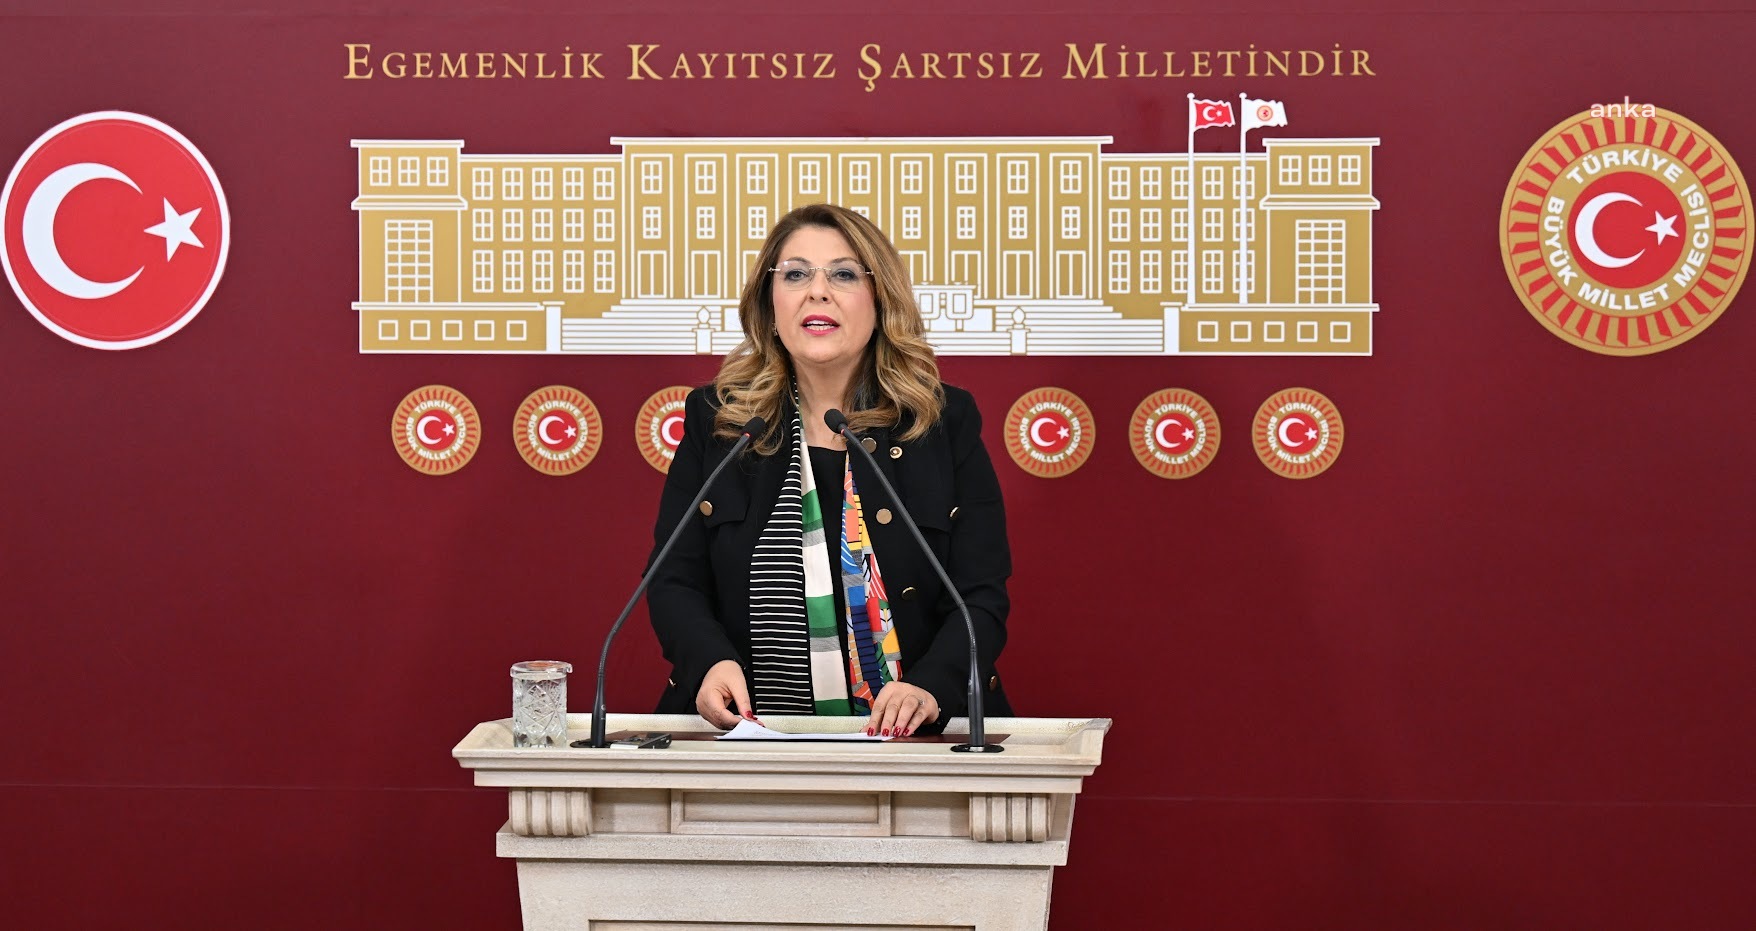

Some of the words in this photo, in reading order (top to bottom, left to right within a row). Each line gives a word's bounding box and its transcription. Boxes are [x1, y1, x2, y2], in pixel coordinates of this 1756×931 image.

[343, 43, 605, 80] EGEMENLİK
[627, 44, 836, 81] KAYITSIZ
[857, 43, 1043, 93] ŞARTSIZ
[1062, 42, 1376, 79] MİLLETİNDİR
[1566, 148, 1683, 185] TÜRKİYE
[1543, 196, 1578, 286] BÜYÜK
[1577, 282, 1669, 311] MİLLET
[1673, 183, 1711, 288] MECLİSİ
